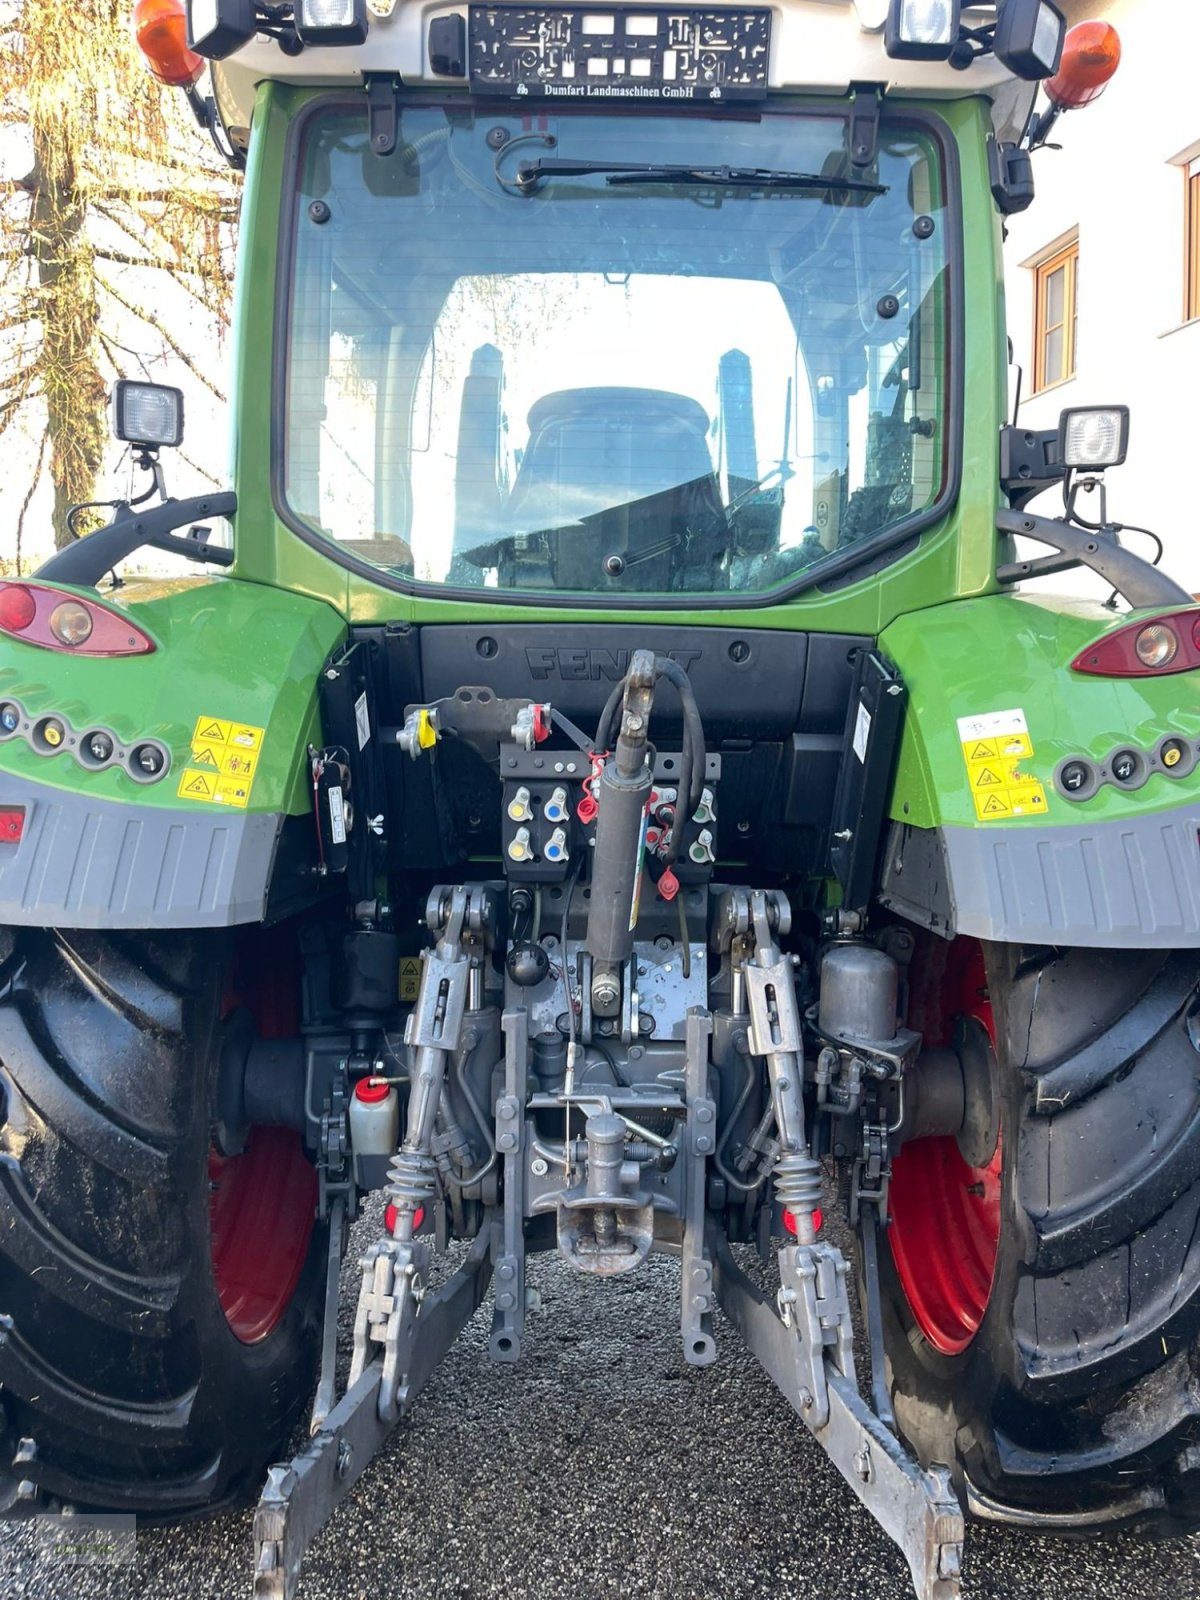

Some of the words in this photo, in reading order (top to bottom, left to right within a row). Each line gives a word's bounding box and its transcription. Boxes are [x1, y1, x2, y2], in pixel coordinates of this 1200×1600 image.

[544, 84, 585, 96] Dumfart
[586, 85, 660, 97] Landmaschinen
[661, 86, 694, 98] GmbH
[525, 647, 702, 681] FENT
